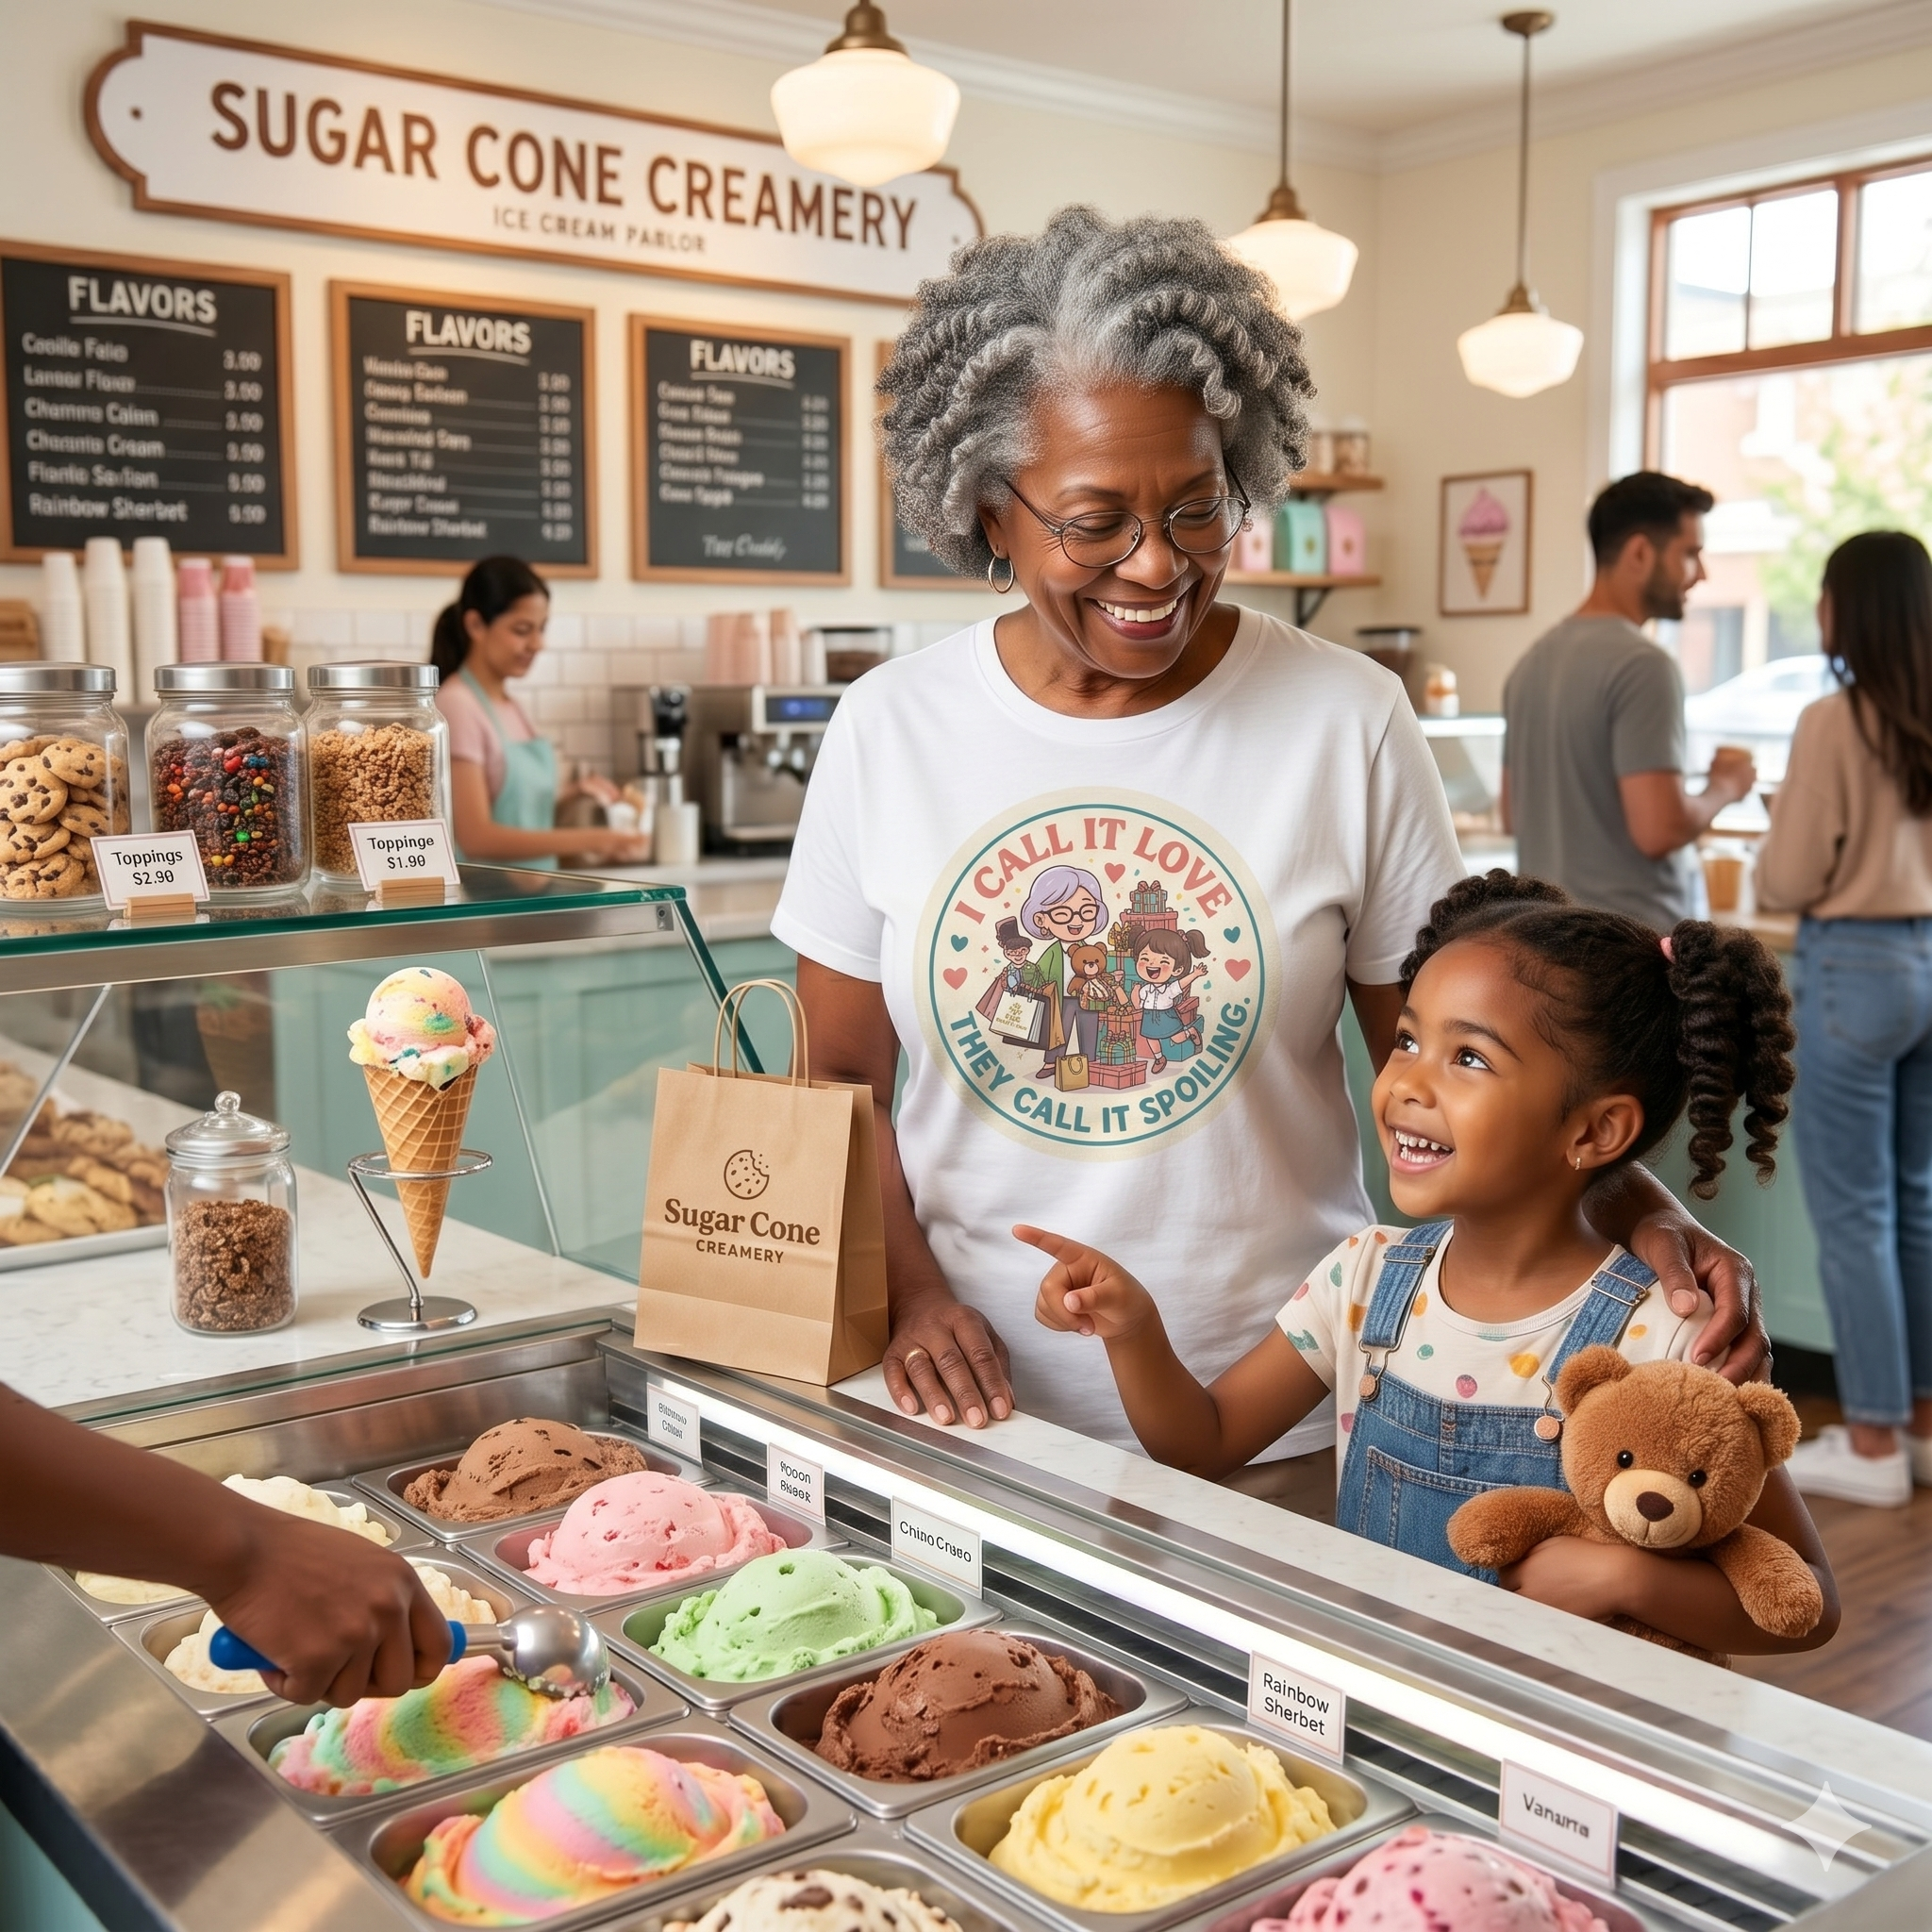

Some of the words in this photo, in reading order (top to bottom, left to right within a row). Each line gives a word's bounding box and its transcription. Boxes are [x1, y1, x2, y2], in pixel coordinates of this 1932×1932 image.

[211, 81, 439, 180] SUGAR
[466, 125, 625, 208] CONE
[647, 154, 917, 251] CREAMERY
[492, 205, 529, 231] ICE
[539, 212, 617, 242] CREAM
[626, 225, 706, 254] PARLOR
[68, 275, 218, 325] FLAVORS
[405, 308, 533, 355] FLAVORS
[690, 339, 796, 380] FLAVORS
[29, 492, 109, 519] Rainbow
[111, 496, 189, 523] Sherbet
[110, 849, 184, 868] Toppings
[955, 900, 986, 925] I
[974, 824, 1074, 900] CALL
[1083, 817, 1126, 851] IT
[1132, 826, 1233, 919] LOVE
[950, 1010, 1015, 1092] THEY
[1013, 1087, 1091, 1133] CALL
[1102, 1106, 1131, 1134] IT
[1138, 996, 1252, 1124] SPOILING.
[664, 1198, 746, 1236] Sugar
[750, 1211, 821, 1245] Cone
[696, 1239, 785, 1264] CREAMERY
[1263, 1673, 1330, 1714] Rainbow
[1264, 1696, 1324, 1736] Sherbet
